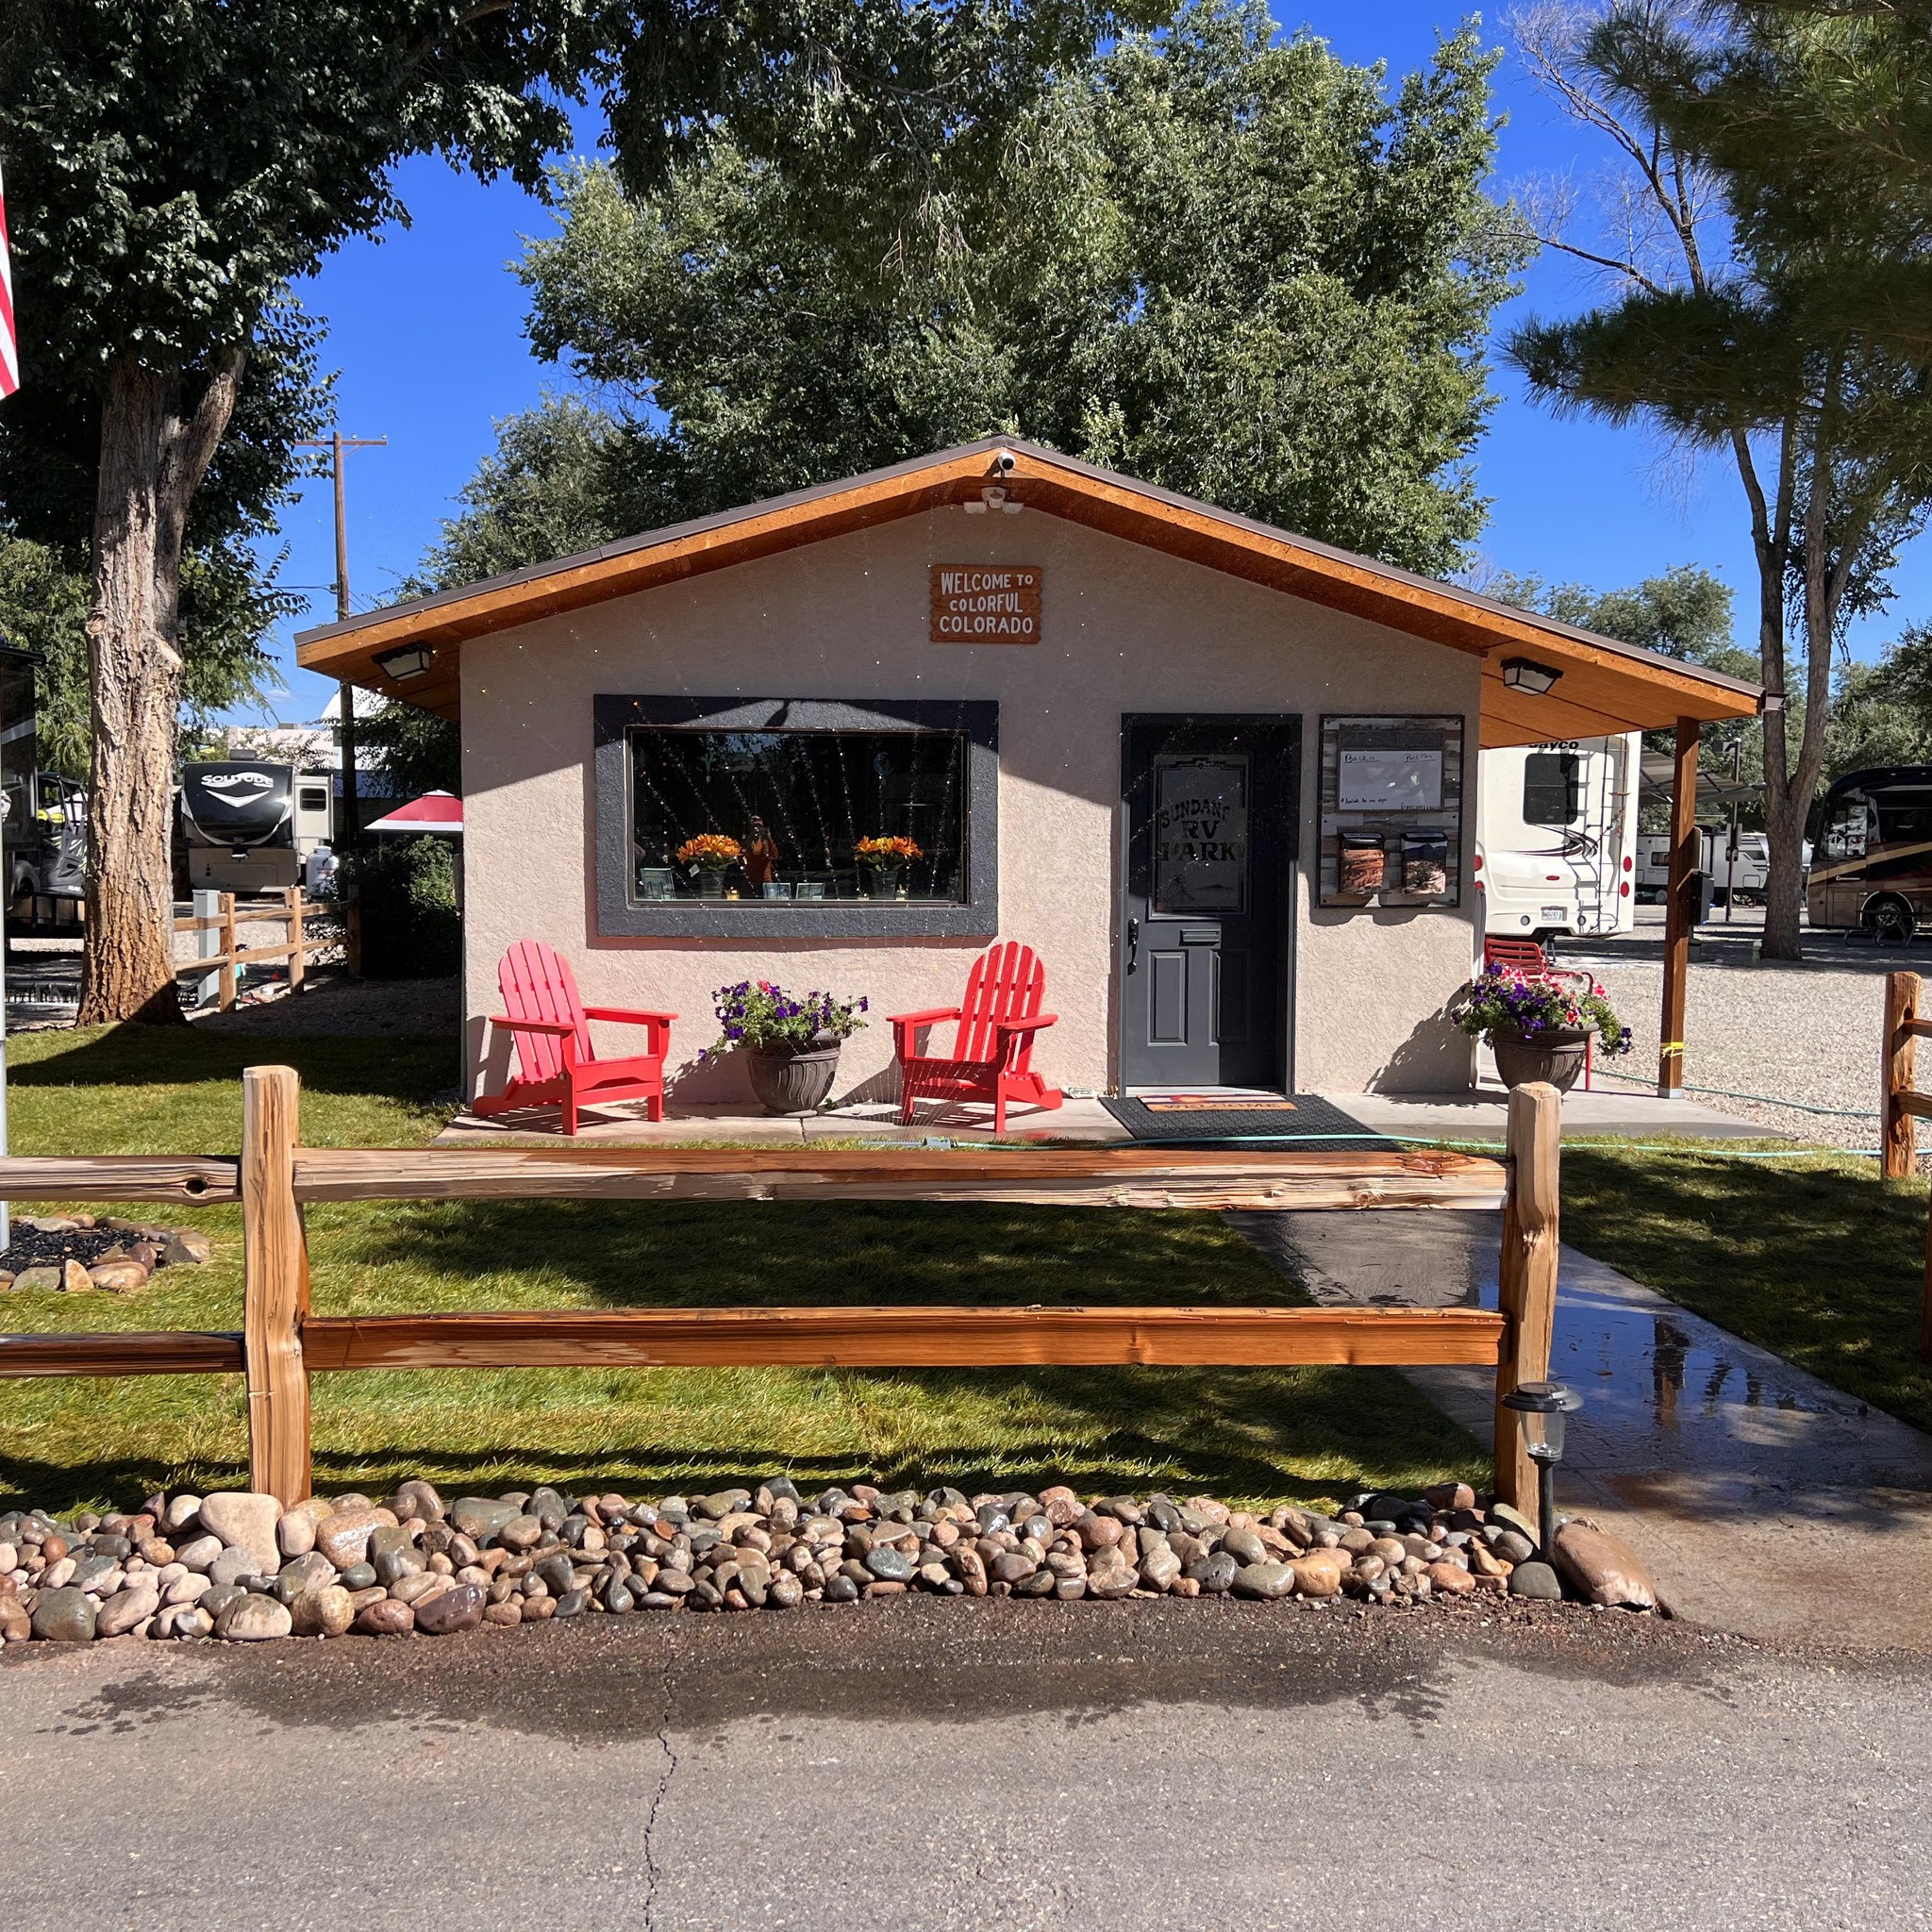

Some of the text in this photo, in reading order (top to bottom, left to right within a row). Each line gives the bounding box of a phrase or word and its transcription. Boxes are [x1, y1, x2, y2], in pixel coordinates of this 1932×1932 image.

[941, 572, 1034, 595] WELCOME TO
[949, 591, 1024, 613] COLORFUL
[939, 615, 1034, 635] COLORADO
[1181, 820, 1221, 839] RV
[1160, 841, 1238, 860] PARK
